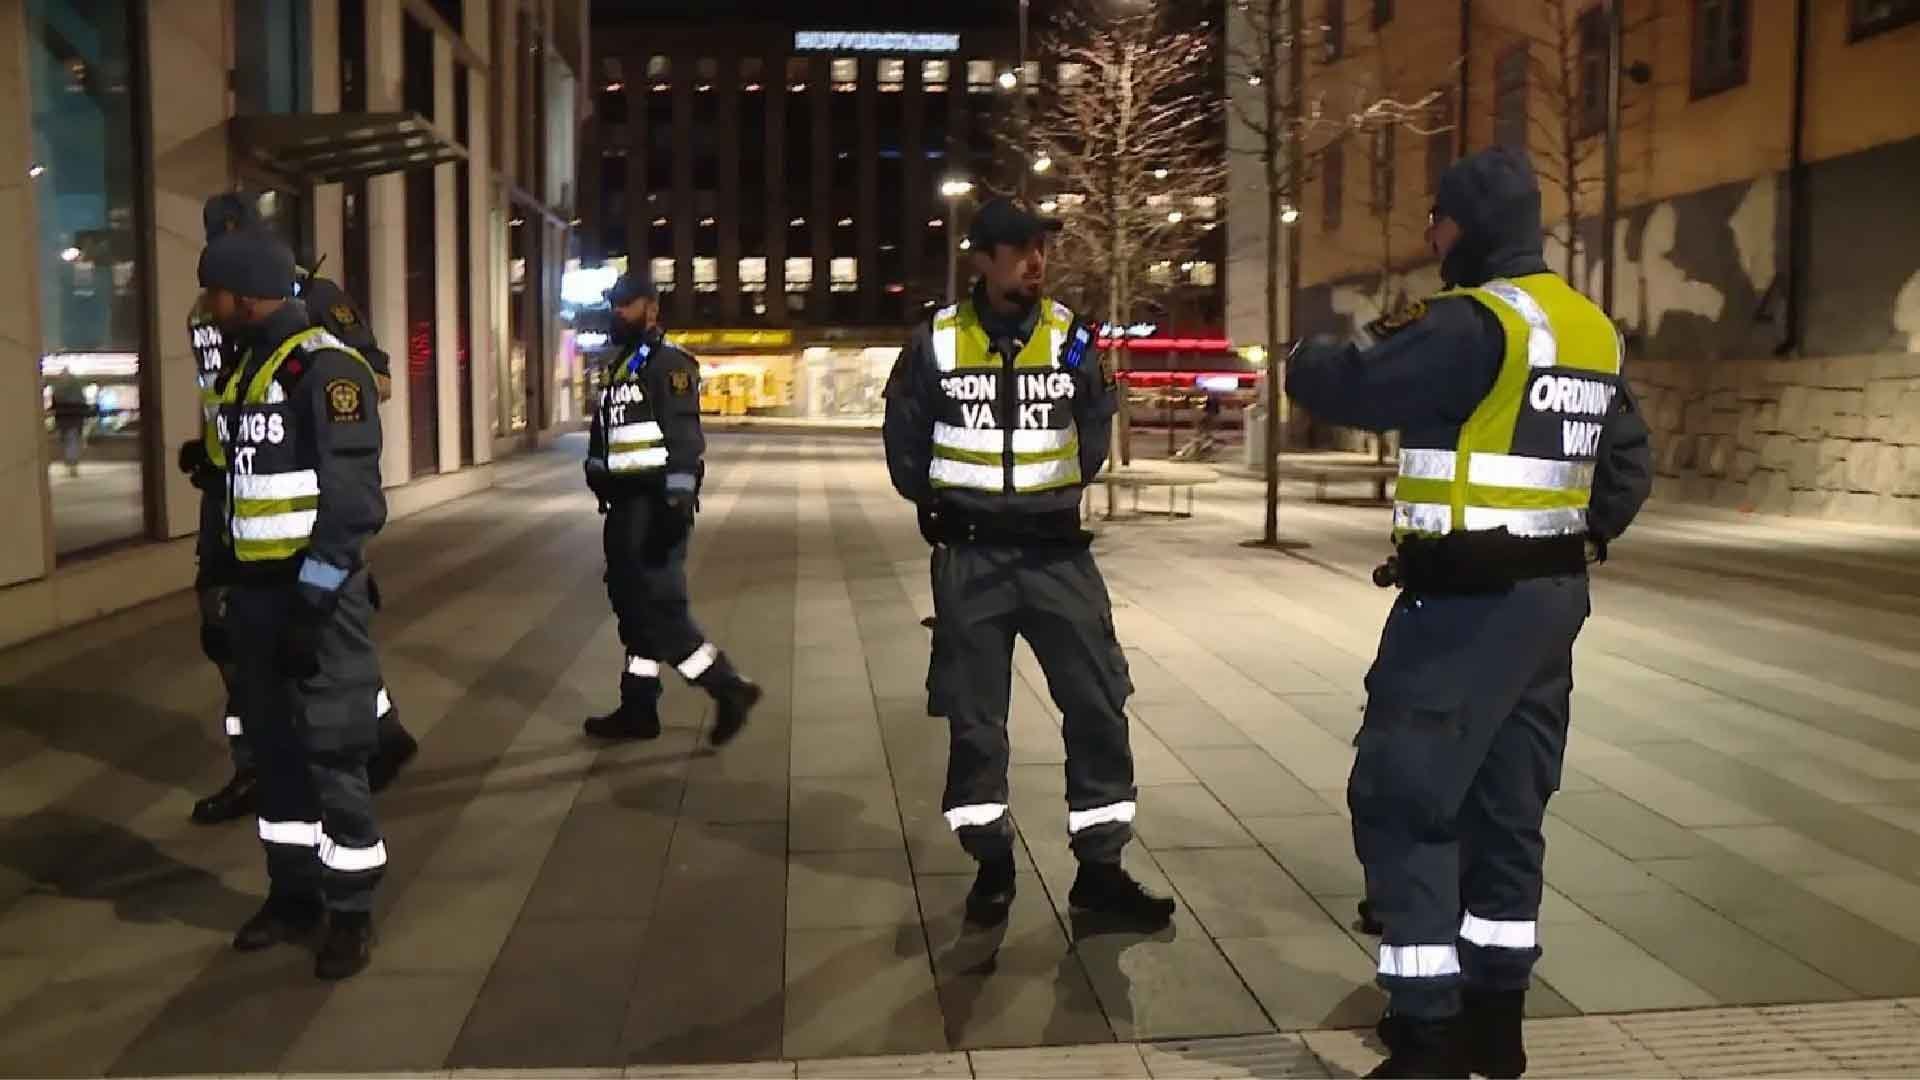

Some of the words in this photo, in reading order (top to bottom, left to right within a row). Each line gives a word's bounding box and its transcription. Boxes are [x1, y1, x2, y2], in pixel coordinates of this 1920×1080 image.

[1530, 374, 1617, 416] ORDNIN
[961, 403, 996, 428] VA
[1018, 403, 1053, 429] KT
